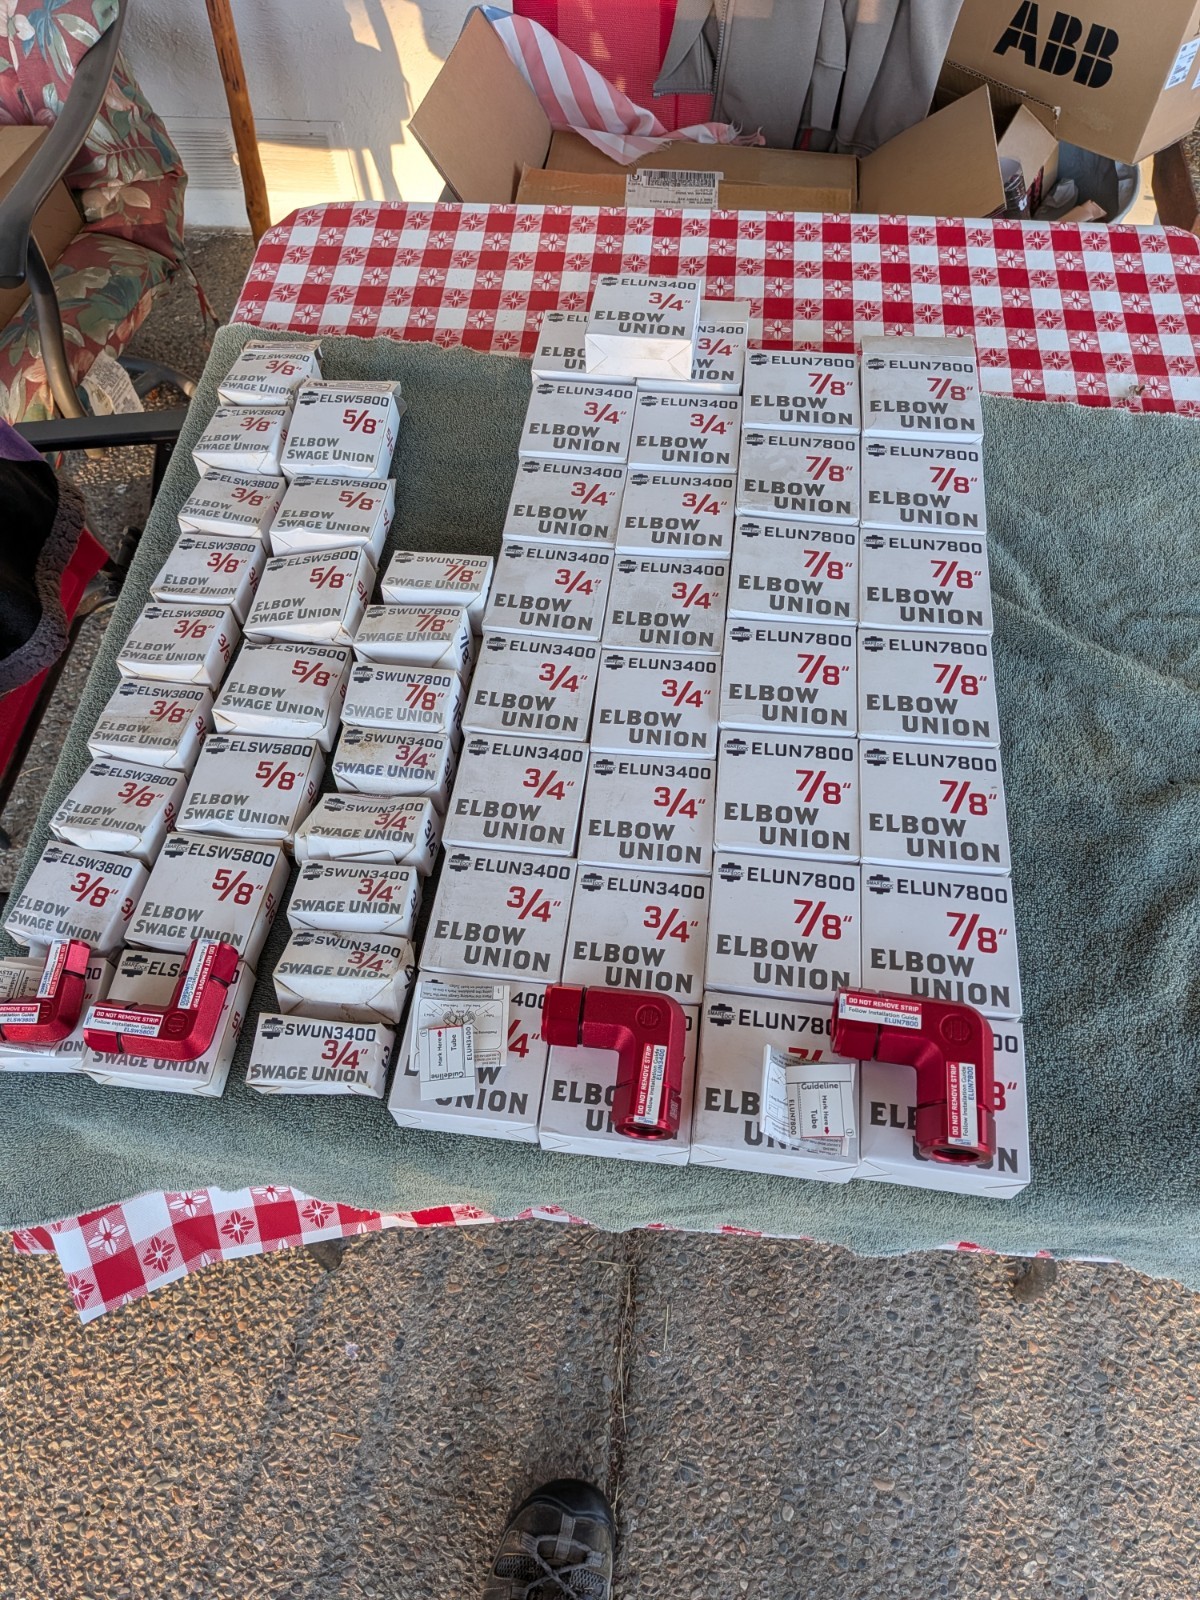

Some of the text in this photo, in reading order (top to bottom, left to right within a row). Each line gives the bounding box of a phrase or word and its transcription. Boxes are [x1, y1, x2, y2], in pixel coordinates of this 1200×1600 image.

[993, 0, 1119, 89] ABB
[621, 279, 696, 290] ELUN3400
[594, 310, 665, 322] ELBOW
[618, 323, 686, 336] UNION
[772, 355, 854, 369] ELUN7800
[320, 394, 389, 407] ELSW5800
[557, 386, 633, 399] ELUN3400
[750, 395, 828, 409] ELBOW
[780, 410, 853, 425] UNION
[529, 423, 600, 437] ELBOW
[290, 437, 340, 447] ELBOW
[553, 437, 620, 453] UNION
[287, 450, 374, 463] SWAGE UNION
[890, 446, 979, 462] ELUN7800
[220, 475, 279, 489] ELSW3800
[652, 476, 733, 488] ELUN3400
[187, 498, 232, 509] ELBOW
[868, 491, 951, 508] ELBOW
[180, 506, 261, 524] SWAGE UNION
[625, 517, 701, 530] ELBOW
[900, 509, 978, 527] UNION
[651, 531, 723, 546] UNION
[764, 526, 855, 545] ELUN7800
[287, 551, 358, 567] ELSW5800
[417, 556, 487, 567] SWUN7800
[526, 549, 609, 565] ELUN3400
[386, 577, 479, 591] SWAGE UNION
[738, 575, 823, 595] ELBOW
[254, 597, 306, 612] ELBOW
[494, 594, 571, 612] ELBOW
[769, 595, 850, 617] UNION
[162, 610, 225, 618] ELSW3800
[250, 608, 341, 623] SWAGE UNION
[519, 612, 593, 631] UNION
[126, 640, 175, 651] ELBOW
[889, 639, 987, 656] ELUN7800
[121, 650, 205, 661] SWAGE UNION
[628, 658, 716, 673] ELUN3400
[375, 671, 451, 687] SWUN7800
[867, 694, 958, 714] ELBOW
[345, 704, 443, 723] SWAGE UNION
[599, 709, 682, 727] ELBOW
[902, 715, 990, 737] UNION
[364, 733, 443, 750] SWUN3400
[628, 728, 707, 748] UNION
[229, 741, 312, 757] ELSW5800
[492, 743, 584, 762] ELUN3400
[752, 742, 854, 762] ELUN7800
[334, 761, 436, 780] SWAGE UNION
[893, 752, 997, 772] ELUN7800
[190, 792, 250, 806] ELBOW
[184, 808, 290, 826] SWAGE UNION
[455, 799, 541, 821] ELBOW
[724, 802, 820, 826] ELBOW
[483, 821, 565, 844] UNION
[869, 813, 967, 837] ELBOW
[759, 826, 850, 850] UNION
[906, 838, 1000, 862] UNION
[60, 852, 132, 879] ELSW3800
[324, 867, 409, 881] SWUN3400
[474, 858, 570, 880] ELUN3400
[747, 866, 854, 891] ELUN7800
[607, 878, 705, 899] ELUN3400
[15, 895, 70, 918] ELBOW
[291, 899, 401, 914] SWAGE UNION
[8, 910, 103, 942] SWAGE UNION
[434, 920, 526, 946] ELBOW
[573, 942, 666, 966] ELBOW
[716, 934, 818, 963] ELBOW
[464, 946, 552, 972] UNION
[605, 966, 693, 993] UNION
[754, 962, 850, 990] UNION
[873, 1001, 899, 1009] REMOVE
[738, 1009, 832, 1036] ELUN78
[869, 1010, 900, 1018] Installation
[884, 1018, 918, 1027] ELUN7800
[284, 1023, 376, 1042] SWUN3400
[251, 1064, 368, 1083] SWAGE UNION
[431, 1071, 464, 1079] Guideline
[638, 1106, 644, 1114] DO
[641, 1065, 650, 1090] REMOVE
[953, 1127, 958, 1135] DO
